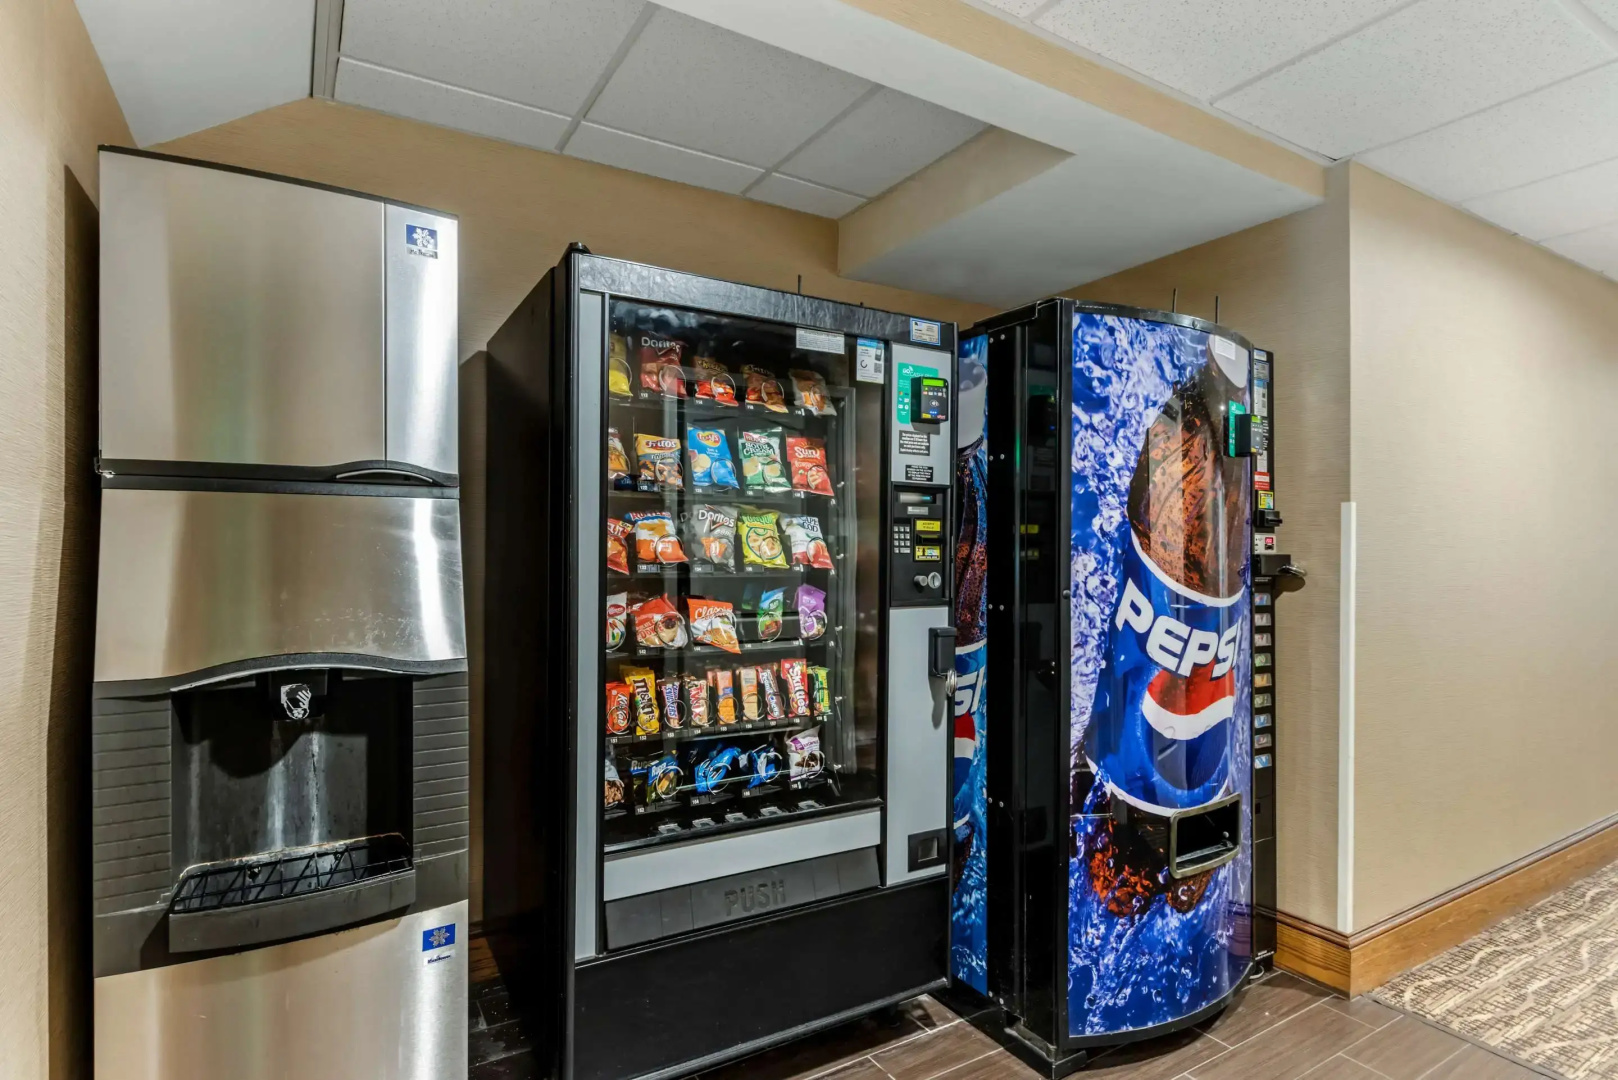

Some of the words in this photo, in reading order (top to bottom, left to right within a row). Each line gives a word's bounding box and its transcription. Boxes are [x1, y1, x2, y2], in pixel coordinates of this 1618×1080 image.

[641, 336, 681, 353] Doritos
[699, 509, 735, 528] Doritos
[802, 522, 819, 532] COD
[1115, 577, 1242, 678] PEPSI
[665, 686, 678, 718] SNICKERS
[690, 684, 704, 719] TWIX
[790, 666, 806, 714] Skittles
[723, 880, 786, 916] PUSH
